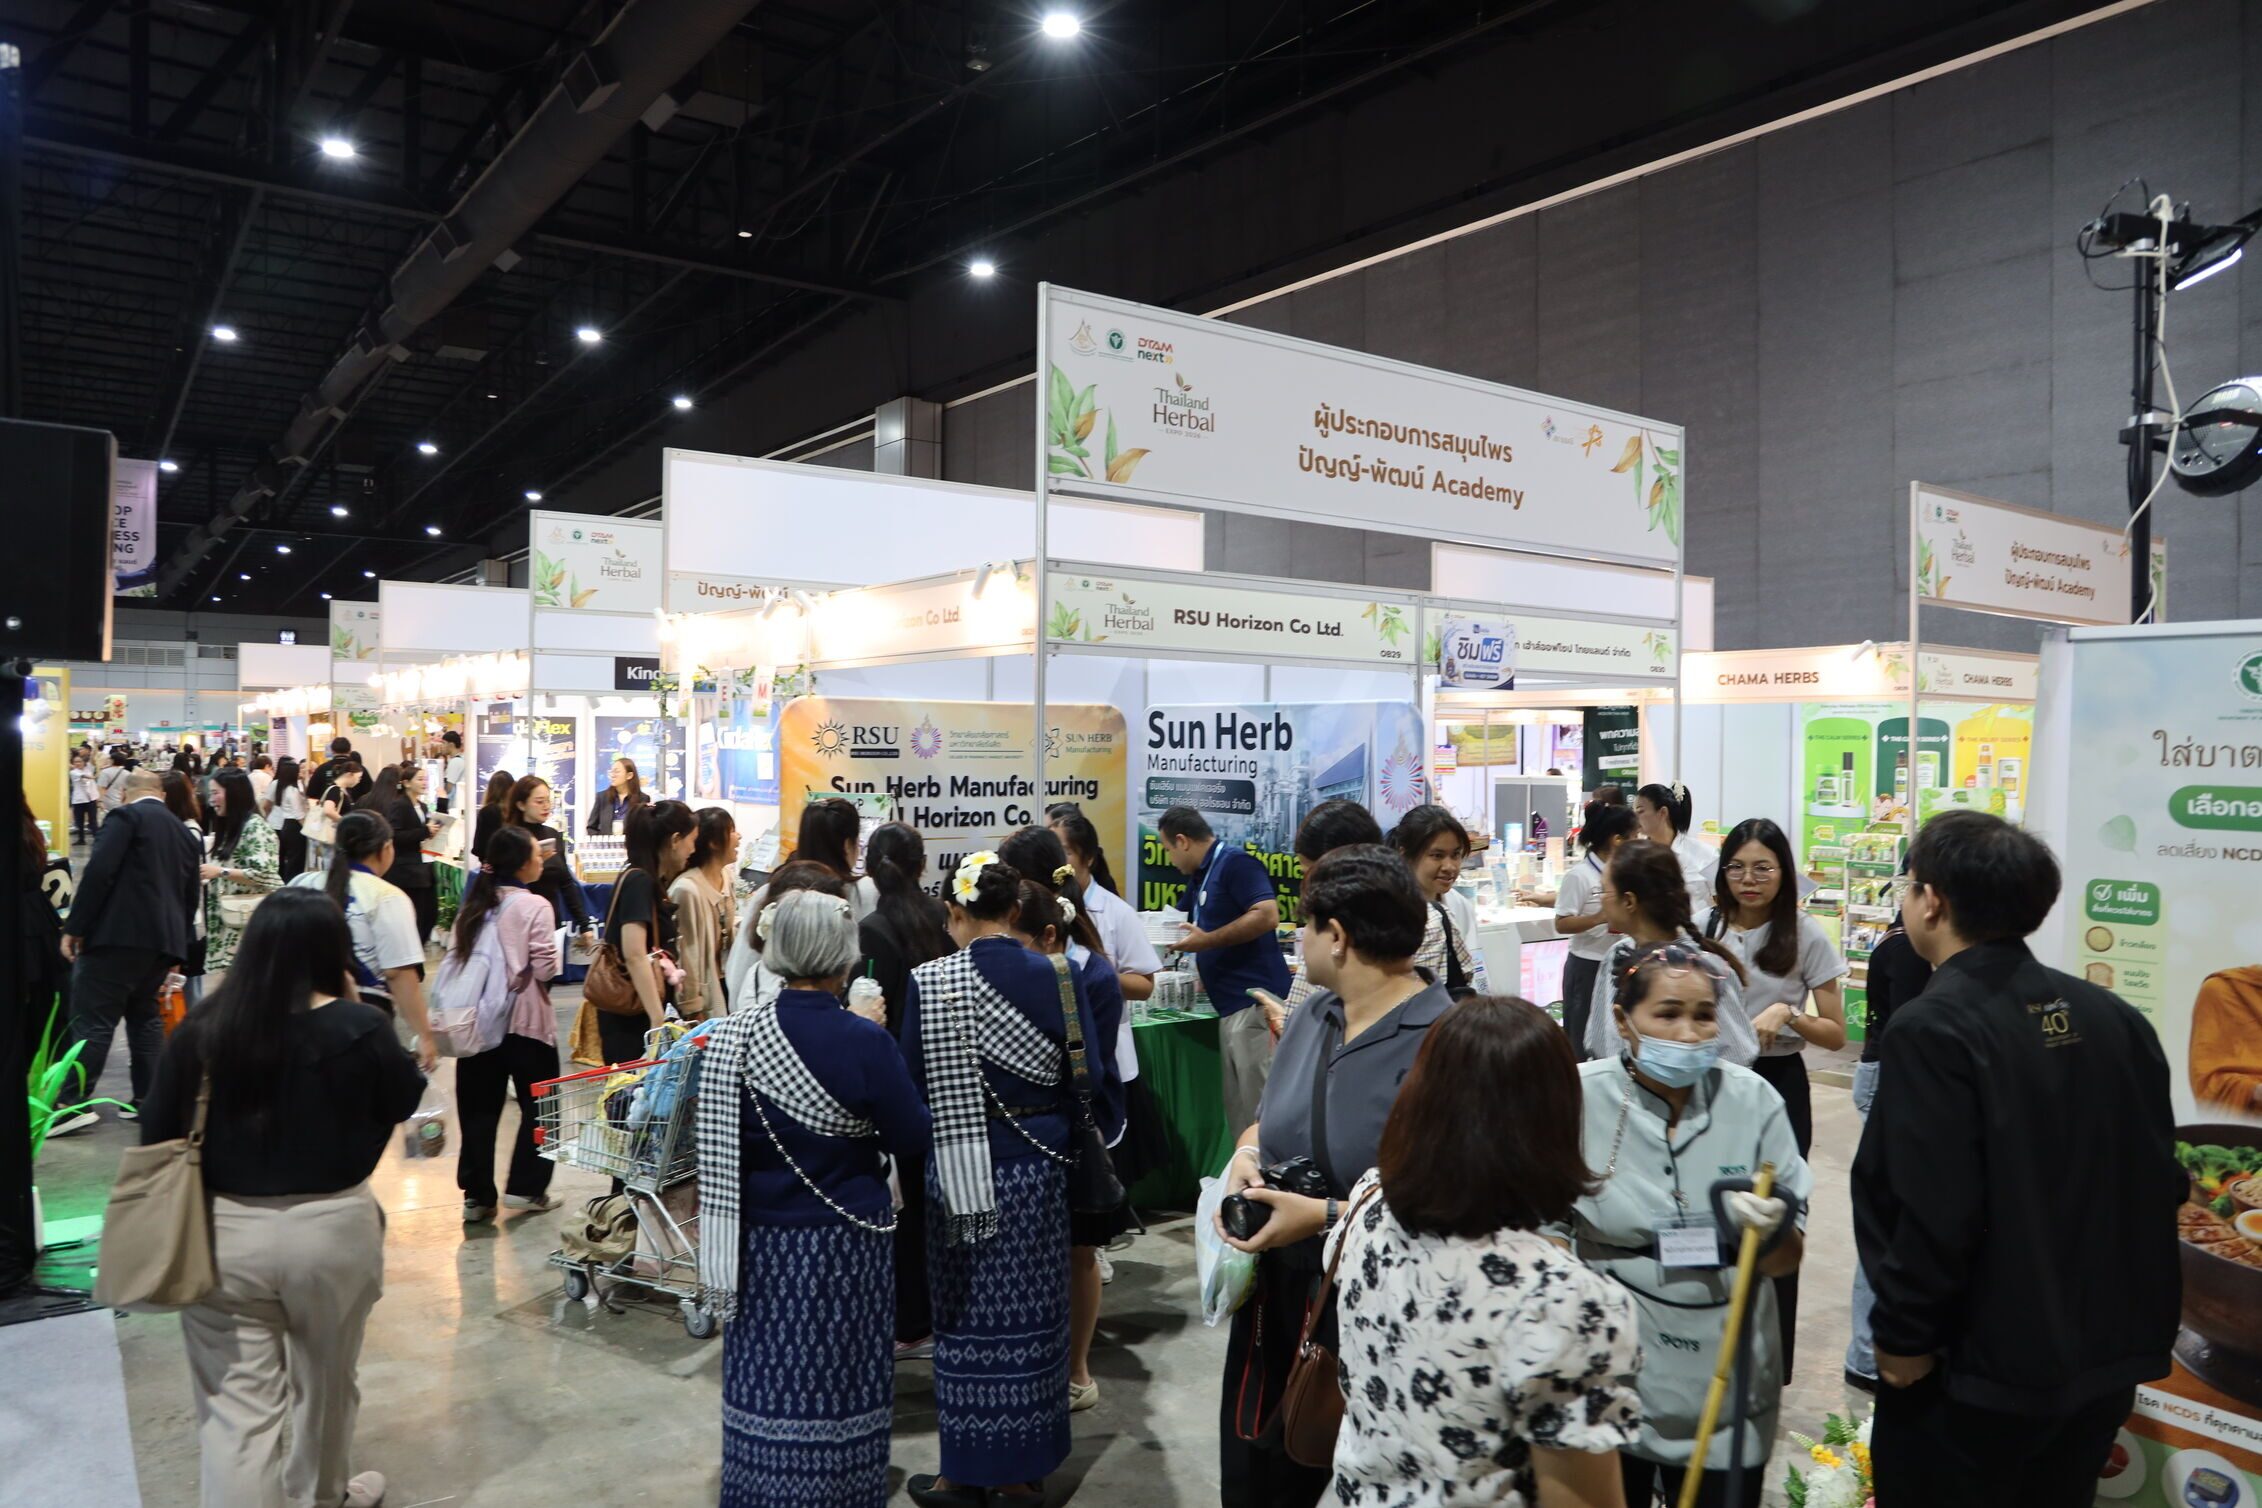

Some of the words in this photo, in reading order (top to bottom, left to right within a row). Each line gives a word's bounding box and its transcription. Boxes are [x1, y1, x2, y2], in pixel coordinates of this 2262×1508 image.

[1137, 349, 1165, 364] next
[1153, 387, 1210, 411] Thailand
[1153, 403, 1215, 433] Herbal
[1314, 402, 1513, 463] ผู้ประกอบการสมุนไพร
[1432, 470, 1524, 510] Academy
[600, 565, 641, 578] Herbal
[2056, 579, 2096, 600] Academy
[1106, 603, 1150, 616] Thailand
[1104, 614, 1154, 631] Herbal
[1173, 608, 1210, 627] RSU
[1216, 612, 1284, 633] Horizon
[1289, 618, 1311, 635] Co
[1316, 621, 1344, 637] Ltd.
[1457, 636, 1502, 661] ชิมฟรี
[1717, 673, 1769, 686] CHAMA
[1774, 671, 1819, 684] HERBS
[852, 726, 899, 745] RSU
[1065, 733, 1085, 742] SUN
[1087, 733, 1112, 743] HERB
[1148, 710, 1205, 750] Sun
[1215, 712, 1293, 751] Herb
[1147, 753, 1258, 778] Manufacturing
[831, 775, 875, 793] Sun
[886, 775, 941, 798] Herb
[913, 805, 996, 828] Horizon
[1004, 804, 1034, 826] Co.
[2117, 883, 2149, 903] เพิ่ม
[2137, 1392, 2160, 1409] โรค
